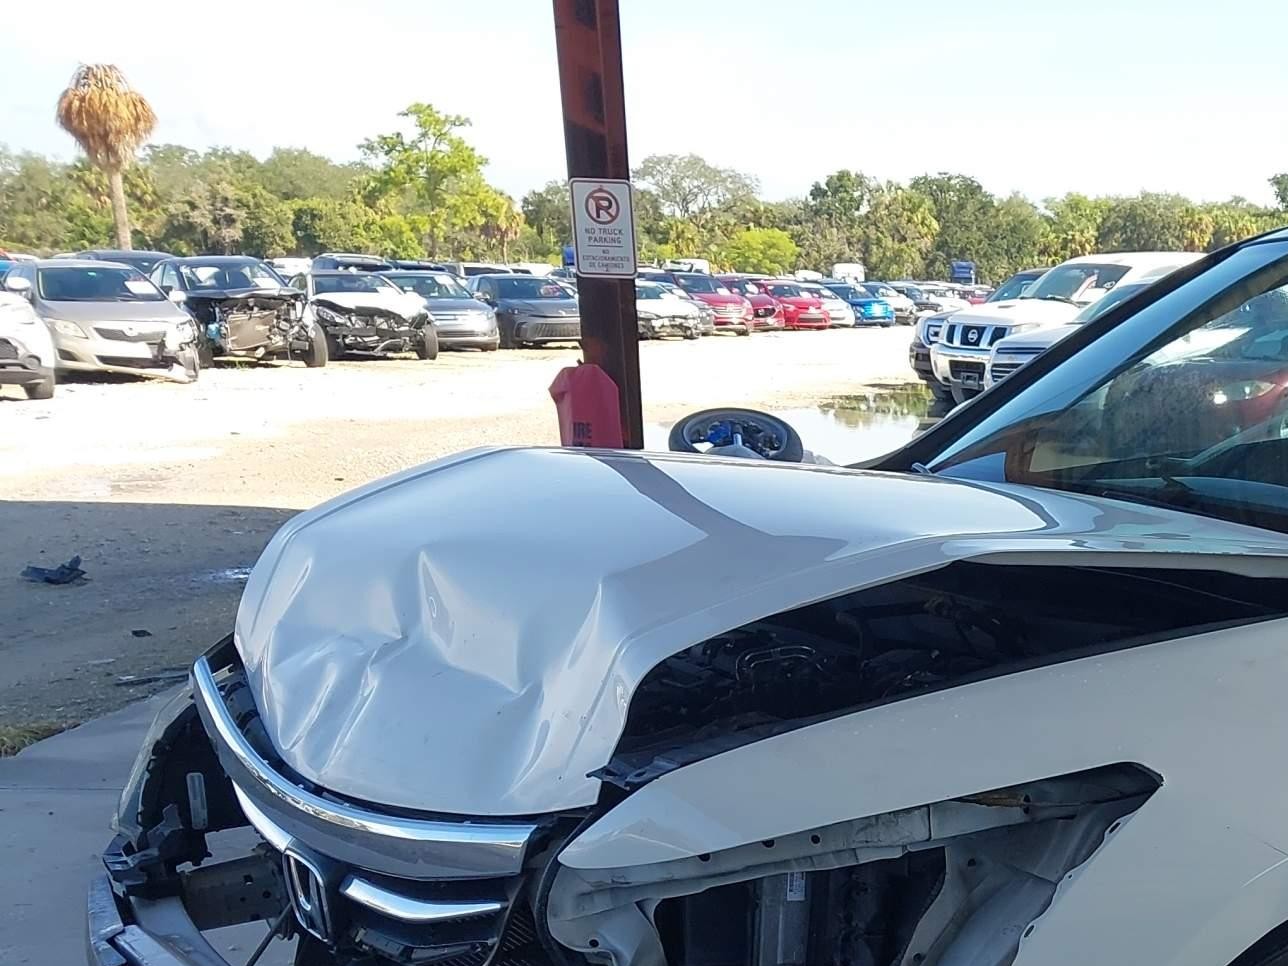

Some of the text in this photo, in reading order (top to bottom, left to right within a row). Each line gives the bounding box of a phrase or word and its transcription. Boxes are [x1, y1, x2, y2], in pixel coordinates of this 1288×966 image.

[584, 227, 624, 236] NO TRUCK
[588, 235, 622, 244] PARKING
